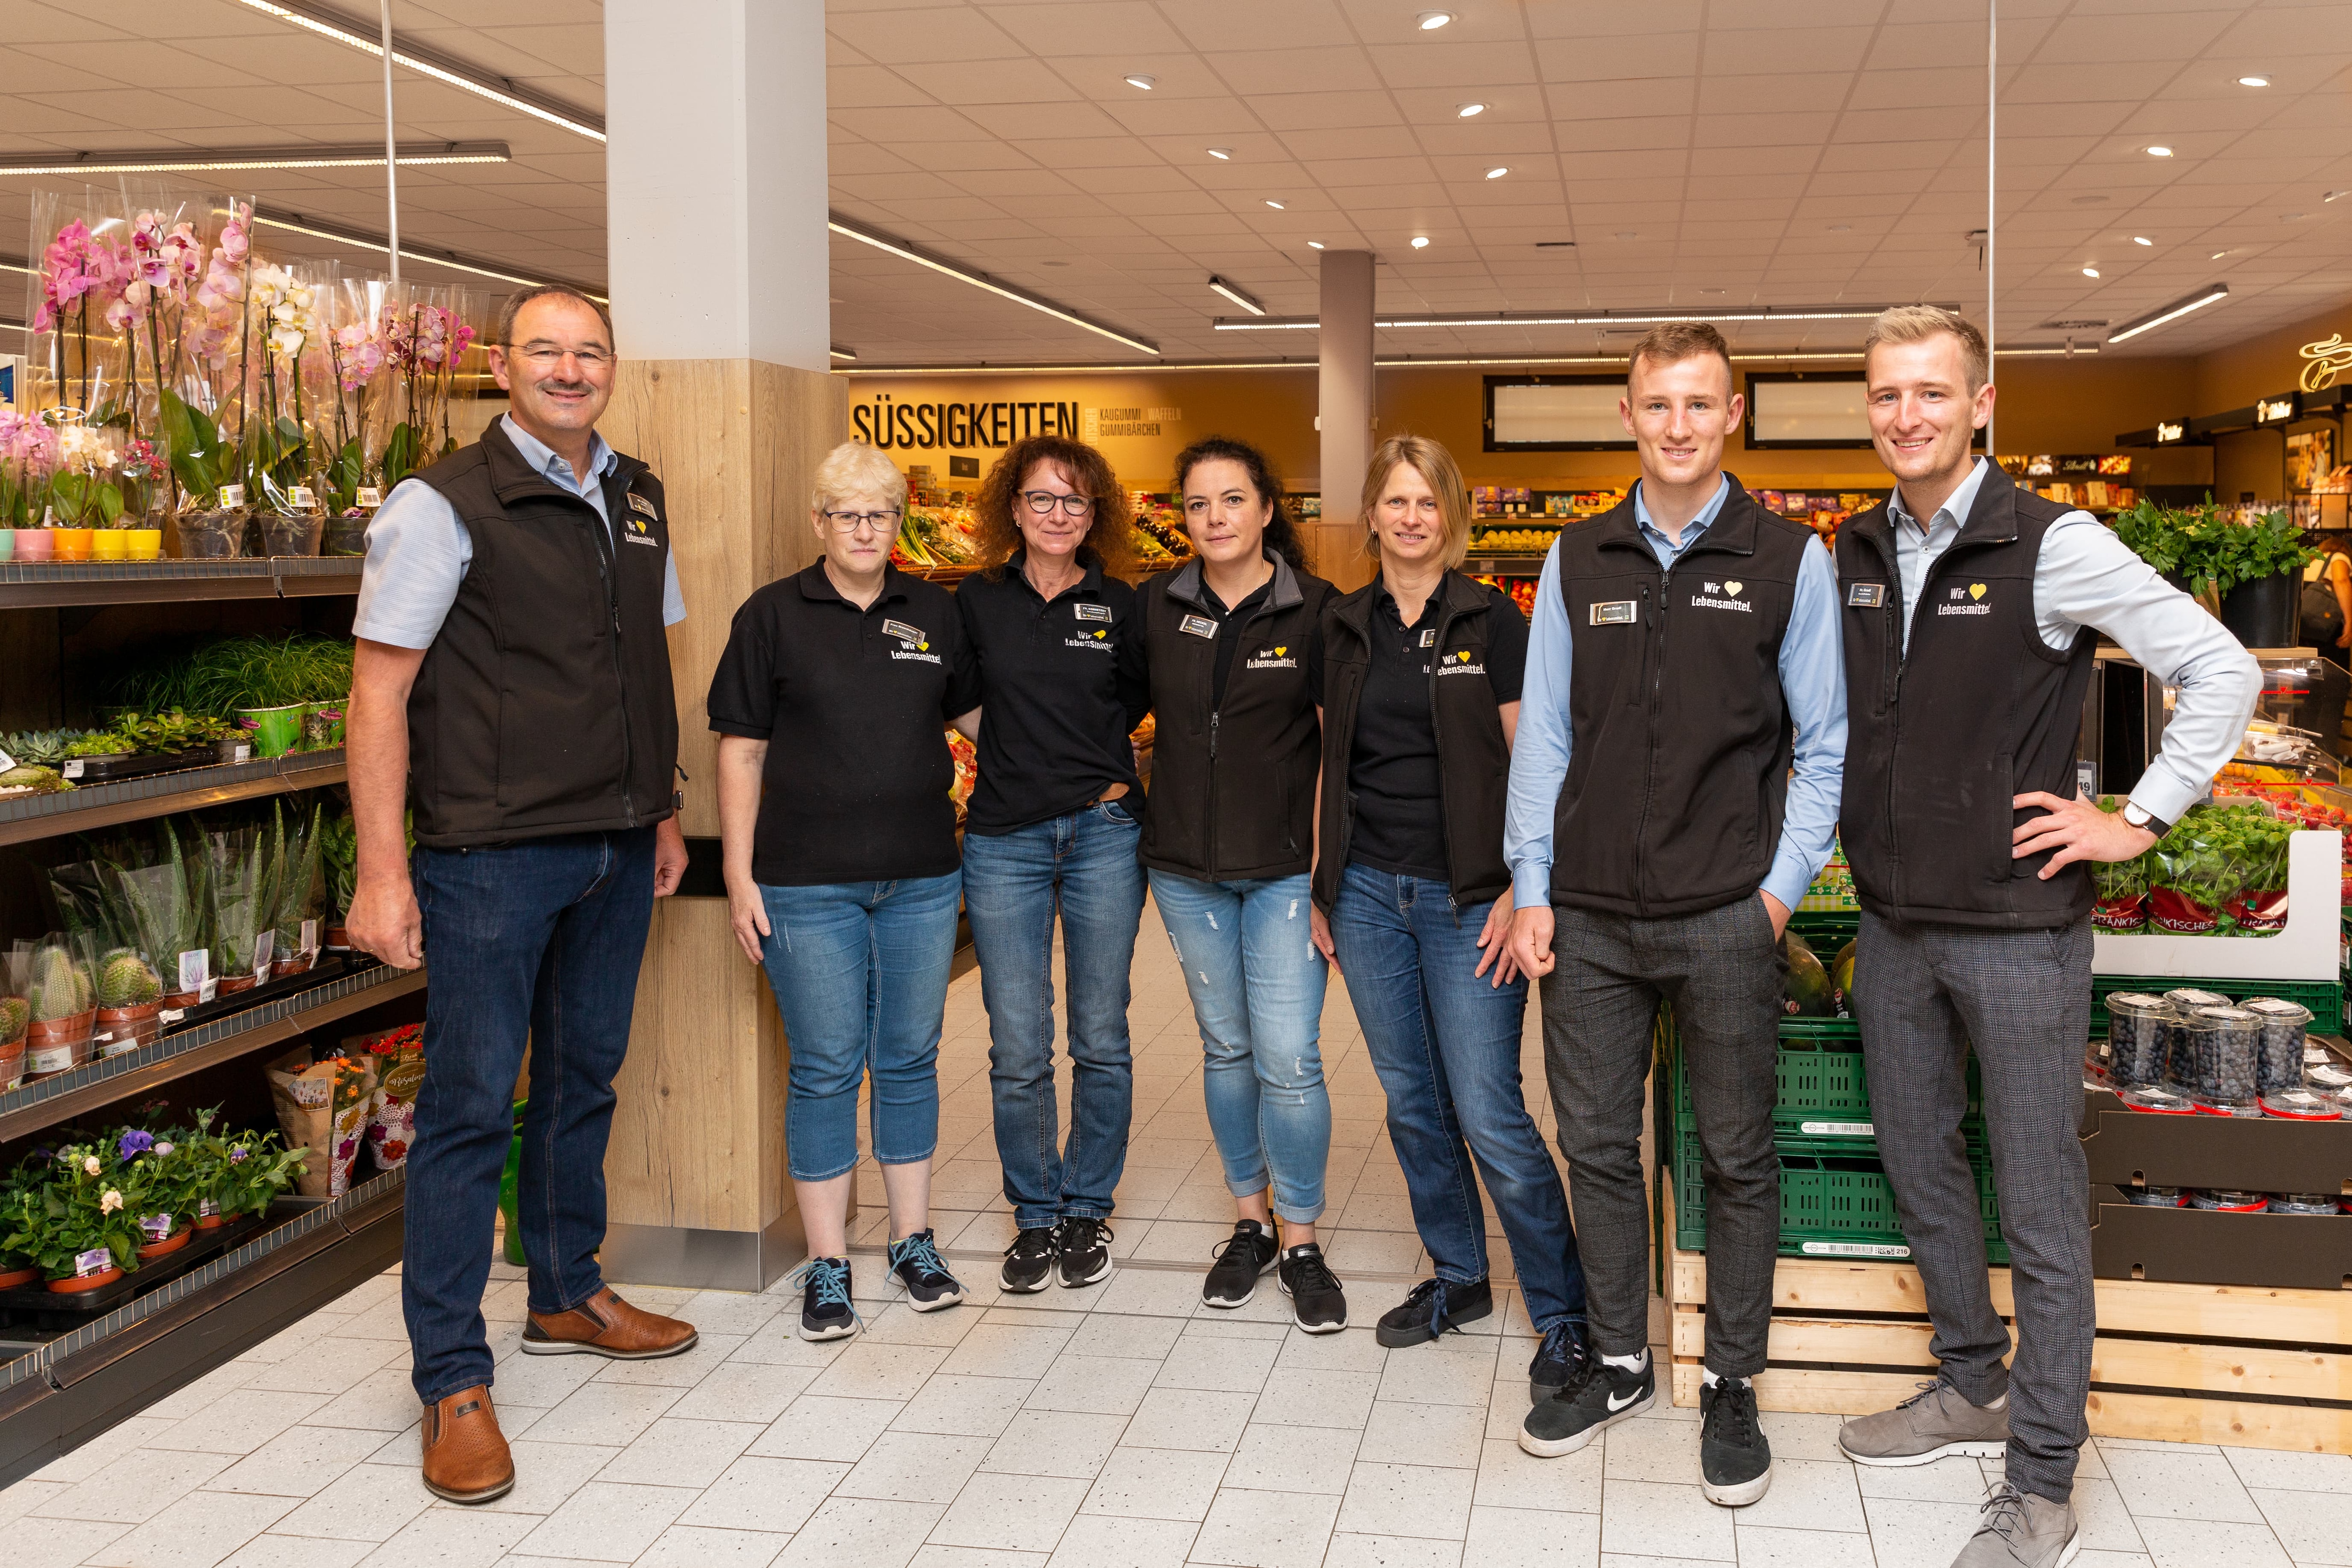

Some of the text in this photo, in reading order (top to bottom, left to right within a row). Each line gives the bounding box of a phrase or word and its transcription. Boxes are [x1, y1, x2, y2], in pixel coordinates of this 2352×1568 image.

[1100, 407, 1181, 421] KAUGUMMI WAFFELN
[853, 394, 1079, 449] SÜSSIGKEITEN
[1100, 422, 1160, 436] GUMMIBÄRCHEN
[626, 520, 636, 531] Wir
[624, 532, 658, 547] Lebensmittel.
[1704, 582, 1721, 594] Wir
[1950, 588, 1965, 600] Wir
[1692, 596, 1752, 613] Lebensmittel.
[1077, 630, 1092, 640] Wir
[900, 641, 915, 650] Wir
[891, 651, 942, 665] Lebensmittel.
[1247, 658, 1297, 669] Lebensmittel.
[1442, 654, 1457, 665] Wir
[1437, 663, 1486, 676] ebensmittel.
[400, 1052, 418, 1062] Fresh
[389, 1073, 426, 1087] Rosalina
